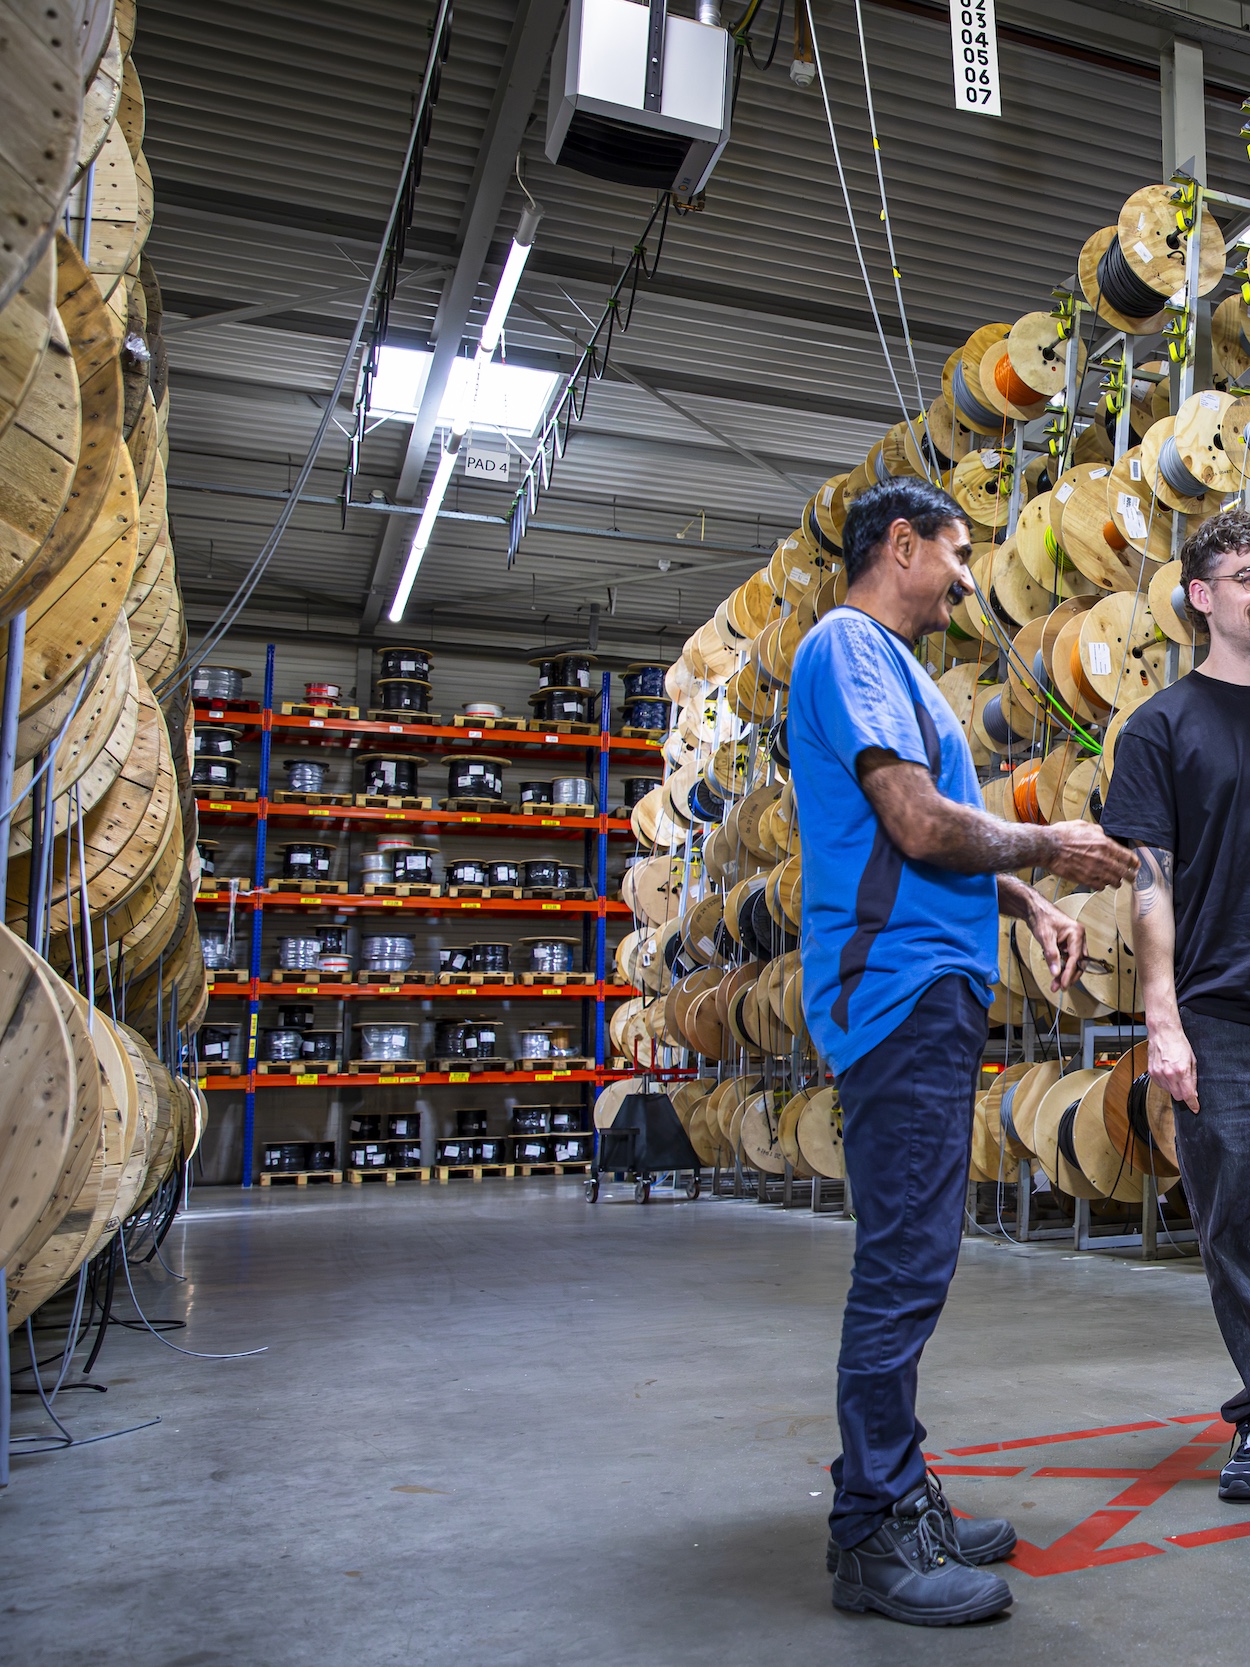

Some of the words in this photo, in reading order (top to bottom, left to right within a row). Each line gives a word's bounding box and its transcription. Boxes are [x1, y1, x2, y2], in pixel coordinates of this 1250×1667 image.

[961, 10, 987, 29] 03
[961, 29, 989, 48] 04
[963, 47, 989, 66] 05
[964, 66, 990, 85] 06
[966, 86, 992, 105] 07
[467, 456, 495, 472] PAD
[499, 462, 508, 474] 4
